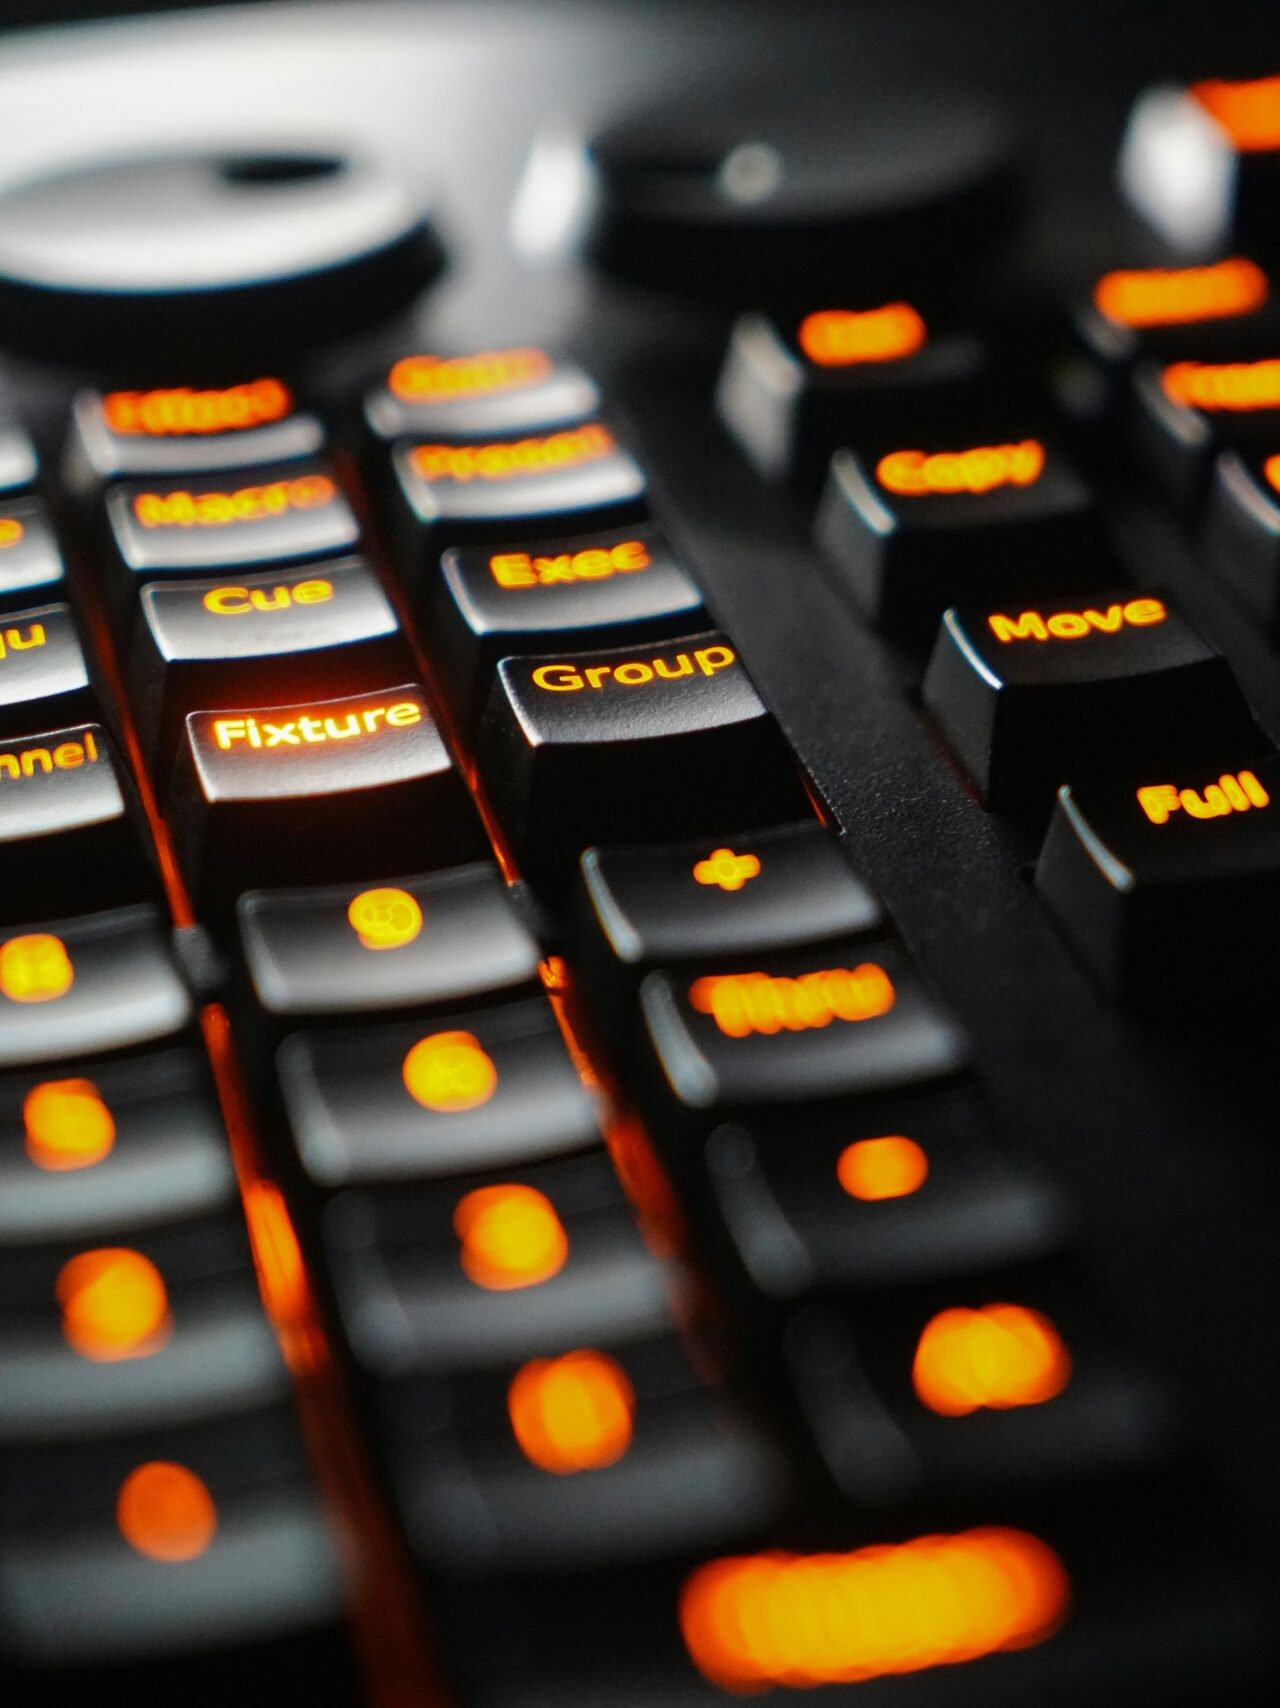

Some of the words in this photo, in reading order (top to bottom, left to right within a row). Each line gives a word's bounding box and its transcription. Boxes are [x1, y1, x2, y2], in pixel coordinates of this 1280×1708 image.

[489, 541, 651, 590] Exec
[203, 579, 333, 615] Cue
[988, 598, 1166, 643] Move
[532, 646, 735, 692] Group
[211, 699, 422, 751] Fixture
[1136, 770, 1270, 825] Full
